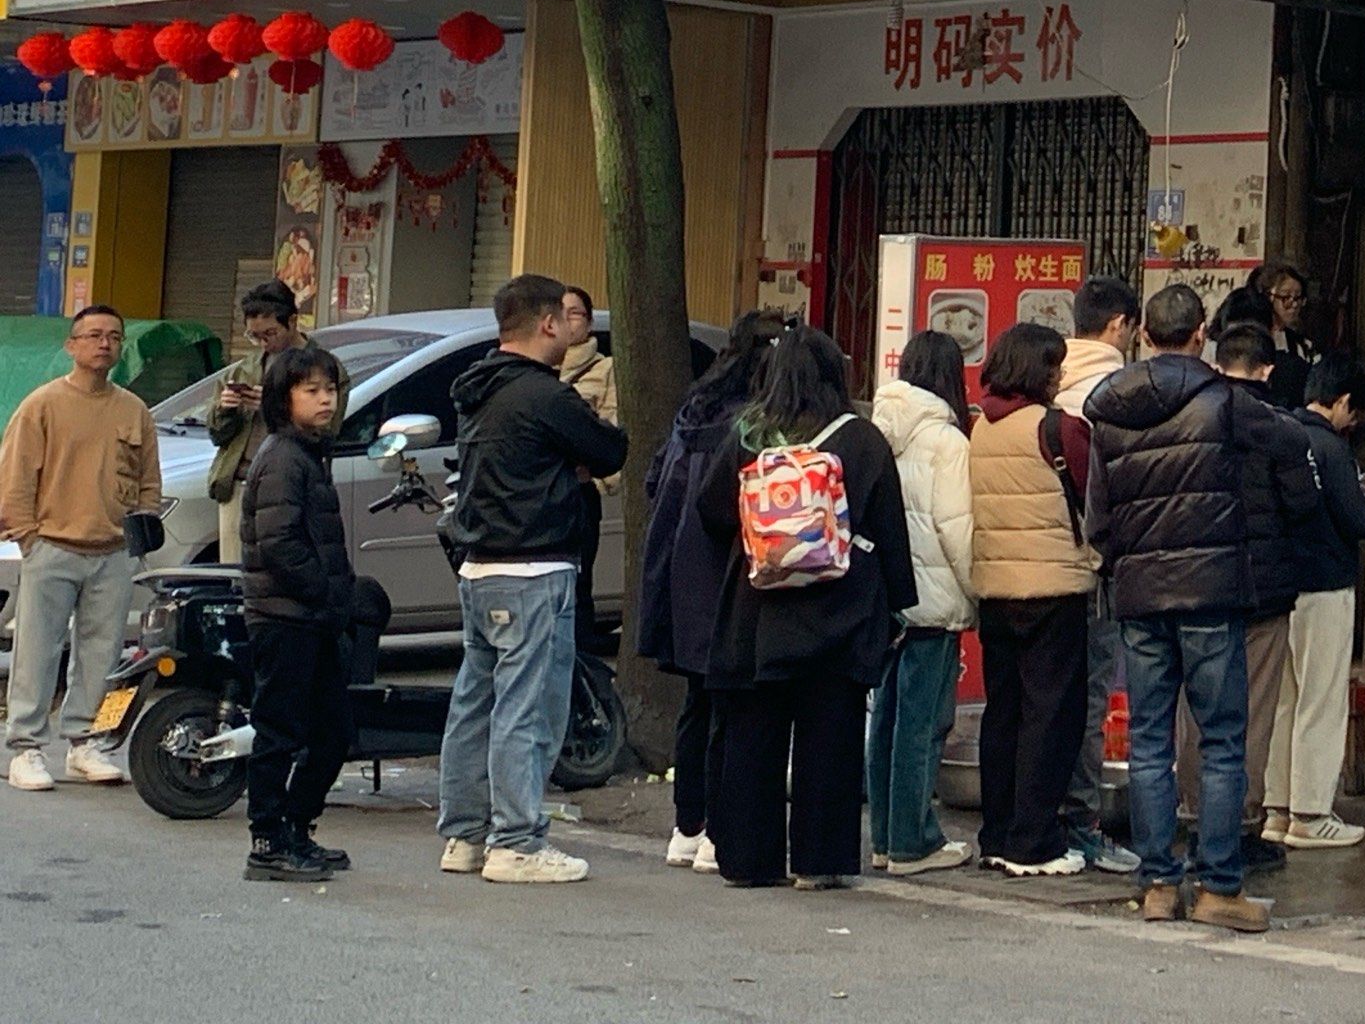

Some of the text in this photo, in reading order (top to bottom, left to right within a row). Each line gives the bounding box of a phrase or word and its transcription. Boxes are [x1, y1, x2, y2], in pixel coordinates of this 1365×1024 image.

[884, 3, 1082, 90] 明码实价
[1014, 253, 1083, 283] 炊生面
